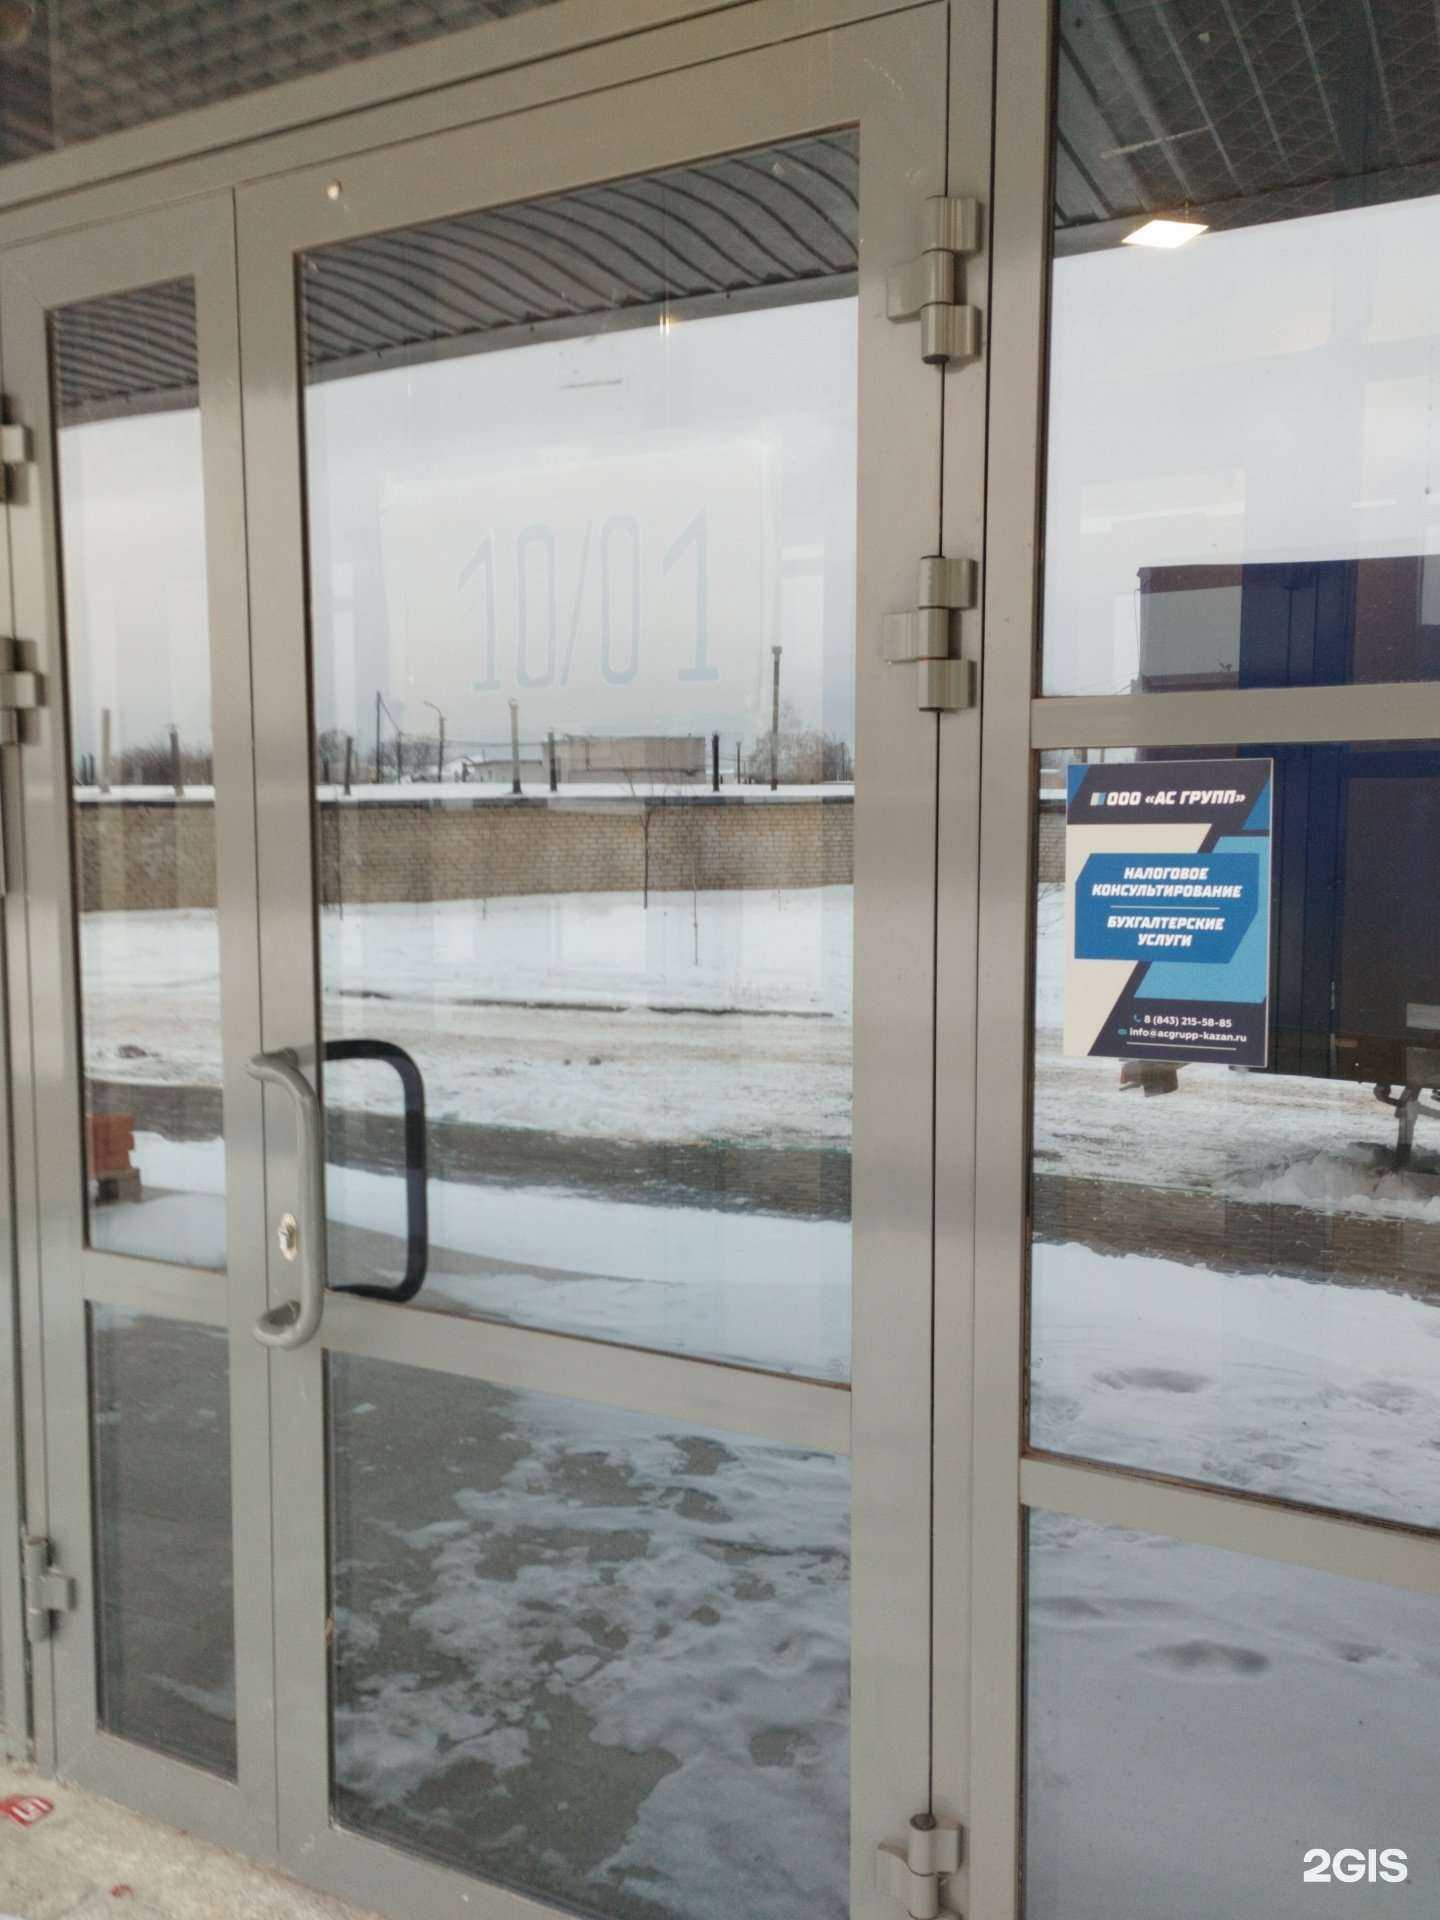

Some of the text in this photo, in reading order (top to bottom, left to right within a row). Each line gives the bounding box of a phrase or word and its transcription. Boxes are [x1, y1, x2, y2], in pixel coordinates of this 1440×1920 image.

[457, 504, 719, 692] 10/01
[1107, 789, 1246, 806] ООО «АС ГРУПП»
[1124, 867, 1209, 881] НАЛОГОВОЕ
[1092, 884, 1242, 898] КОНСУЛЬТИРОВАНИЕ
[1107, 916, 1225, 930] БУХГАЛТЕРСКИЕ
[1137, 933, 1193, 947] УСЛУГИ
[1144, 1015, 1232, 1028] 8 (843) 215-58-85
[1129, 1027, 1247, 1042] info@acgrupp-kazan.ru
